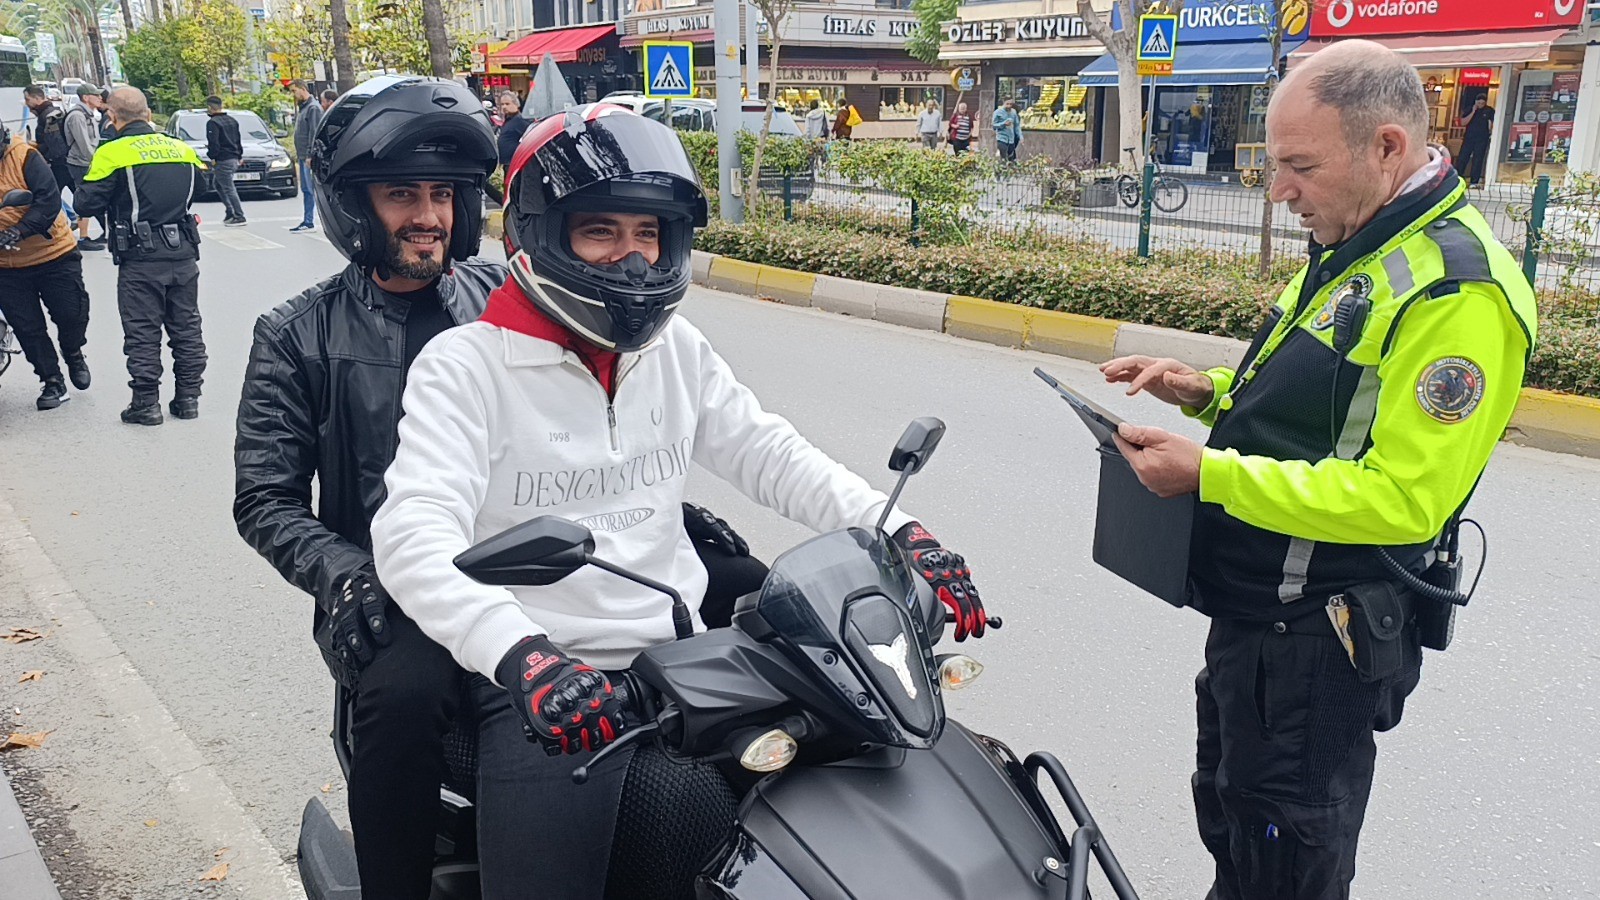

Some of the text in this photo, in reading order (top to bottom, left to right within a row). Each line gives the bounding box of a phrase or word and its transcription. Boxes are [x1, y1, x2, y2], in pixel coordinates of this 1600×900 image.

[1179, 3, 1269, 28] TURKCELL
[1358, 0, 1438, 18] vodafone
[824, 15, 876, 35] İHLAS
[1015, 17, 1090, 40] KUYUM
[901, 71, 929, 81] SAAT
[549, 432, 570, 443] 1998
[513, 436, 692, 508] DESIGN STUDIO
